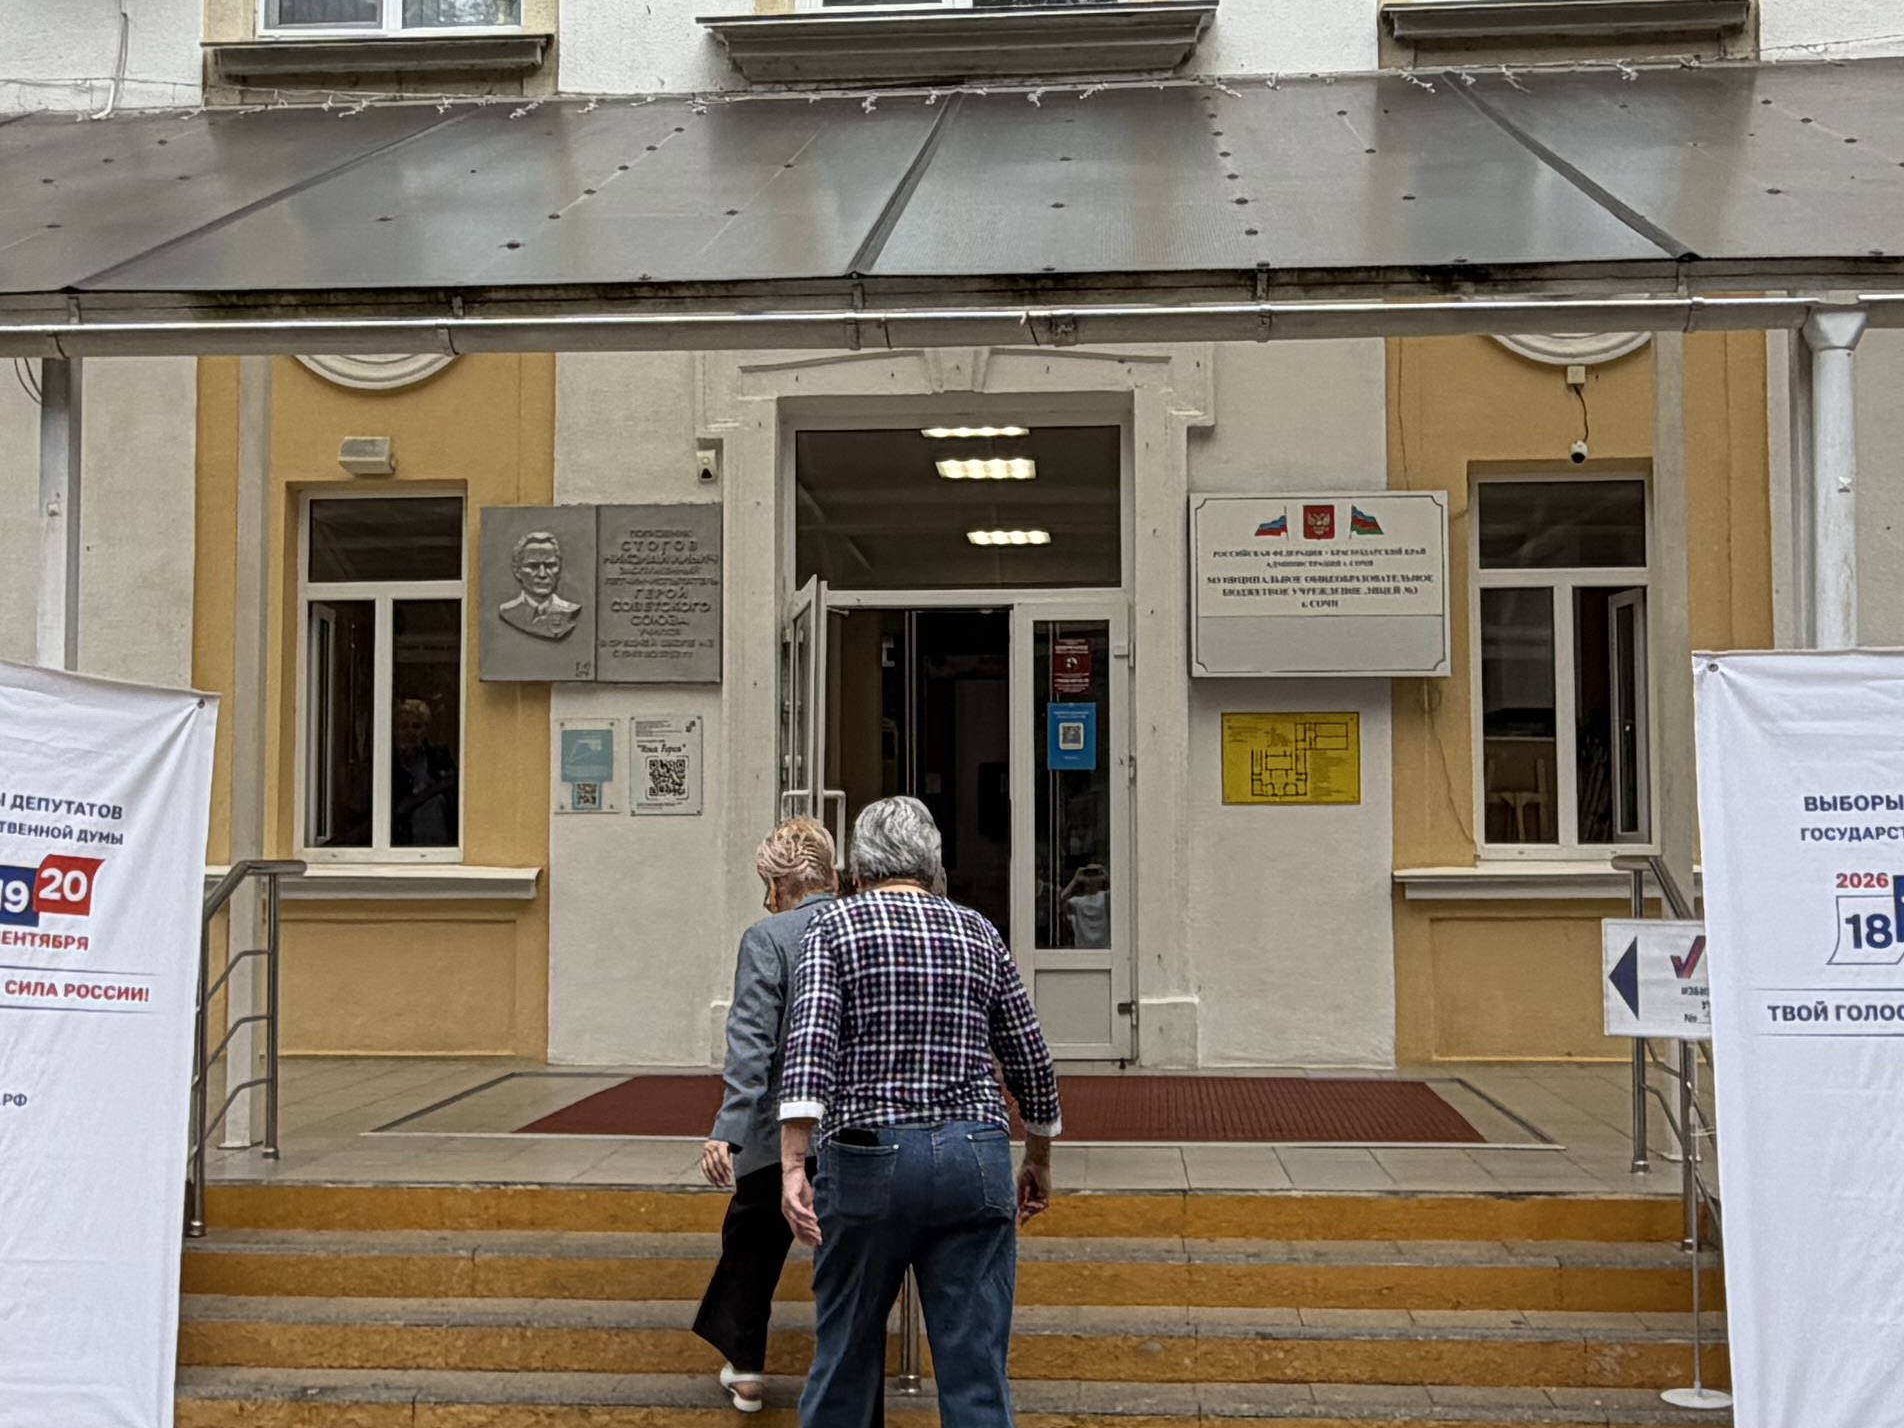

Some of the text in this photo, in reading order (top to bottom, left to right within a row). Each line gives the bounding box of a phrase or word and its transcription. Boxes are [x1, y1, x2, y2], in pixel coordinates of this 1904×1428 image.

[621, 540, 698, 554] СТОГОВ
[633, 586, 689, 600] ГЕРОЙ
[610, 600, 712, 613] СОВЕТСКОГО
[8, 793, 123, 820] ДЕПУТАТОВ
[1803, 794, 1904, 812] ВЫБОРЫ
[76, 829, 124, 846] ДУМЫ
[38, 868, 88, 902] 20
[1835, 871, 1889, 889] 2026
[1844, 913, 1893, 950] 18
[4, 979, 58, 997] СИЛА
[63, 983, 149, 1002] РОССИИ!
[1767, 1001, 1829, 1022] ТВОЙ
